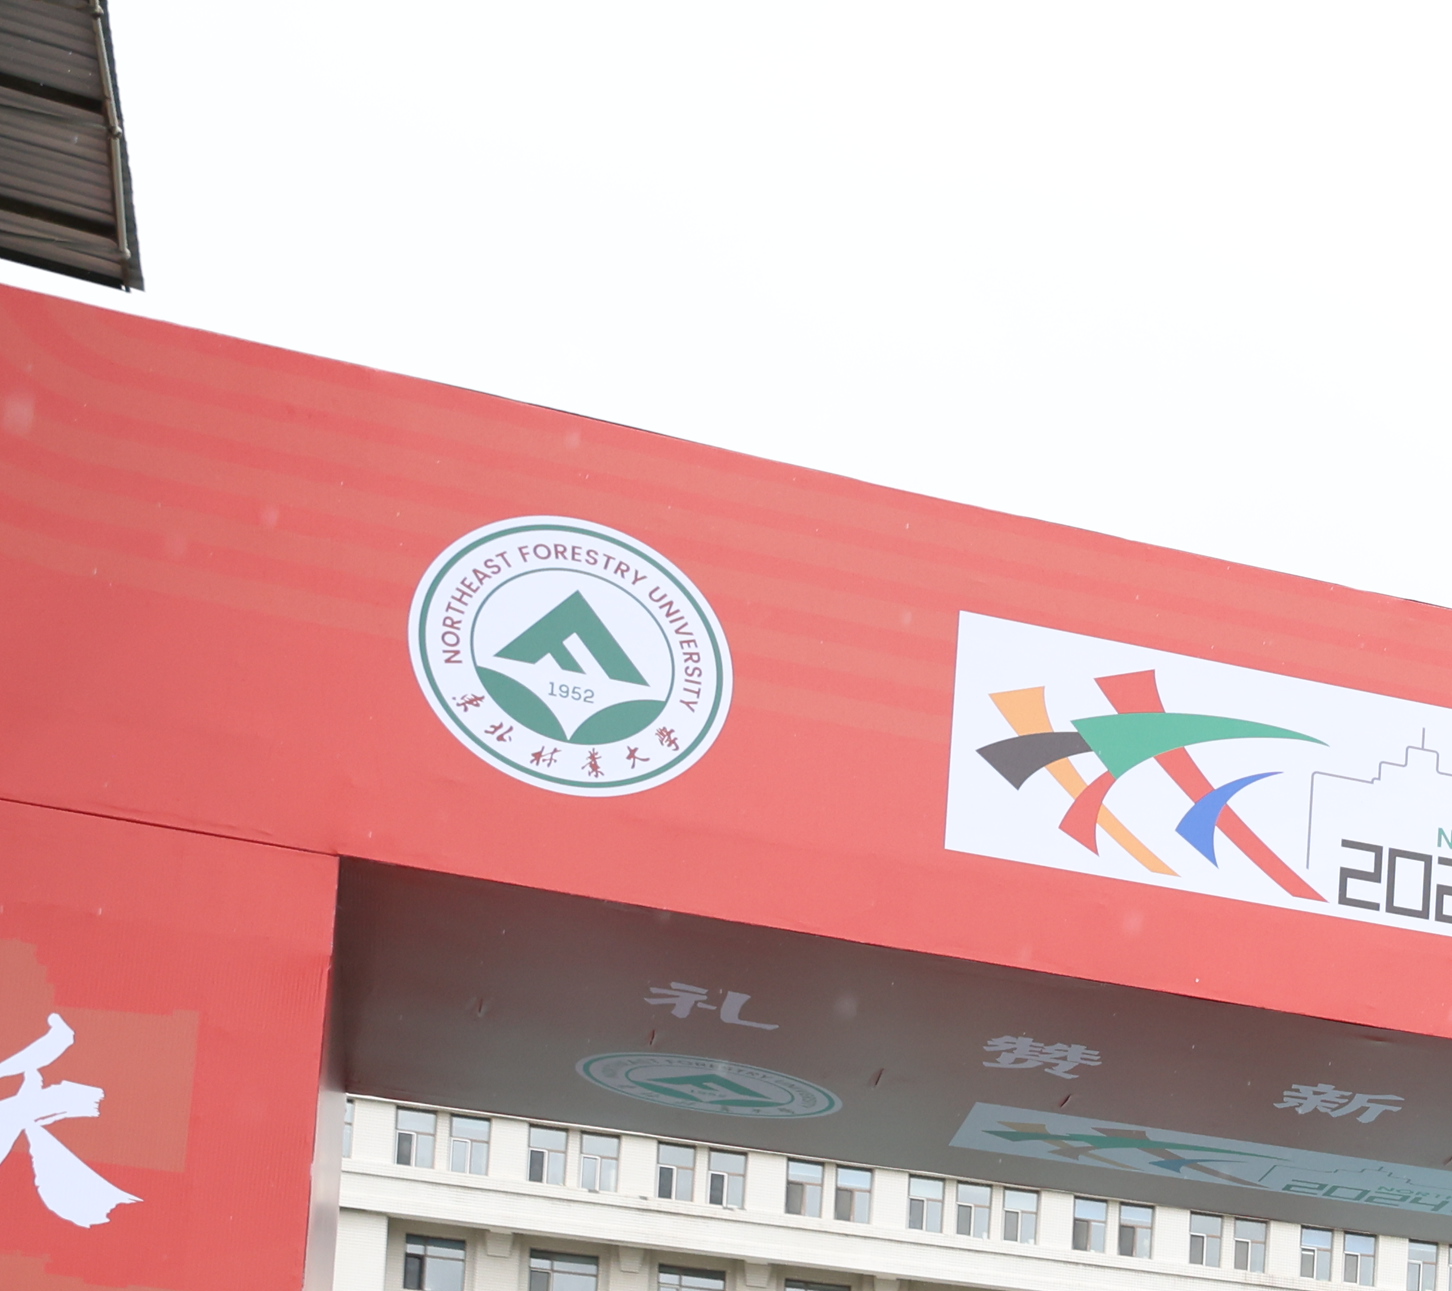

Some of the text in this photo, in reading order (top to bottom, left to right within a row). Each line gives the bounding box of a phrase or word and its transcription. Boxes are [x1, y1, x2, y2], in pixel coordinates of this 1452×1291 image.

[441, 543, 703, 713] NORTHEAST FORESTRY UNIVERSITY
[547, 682, 595, 703] 1952
